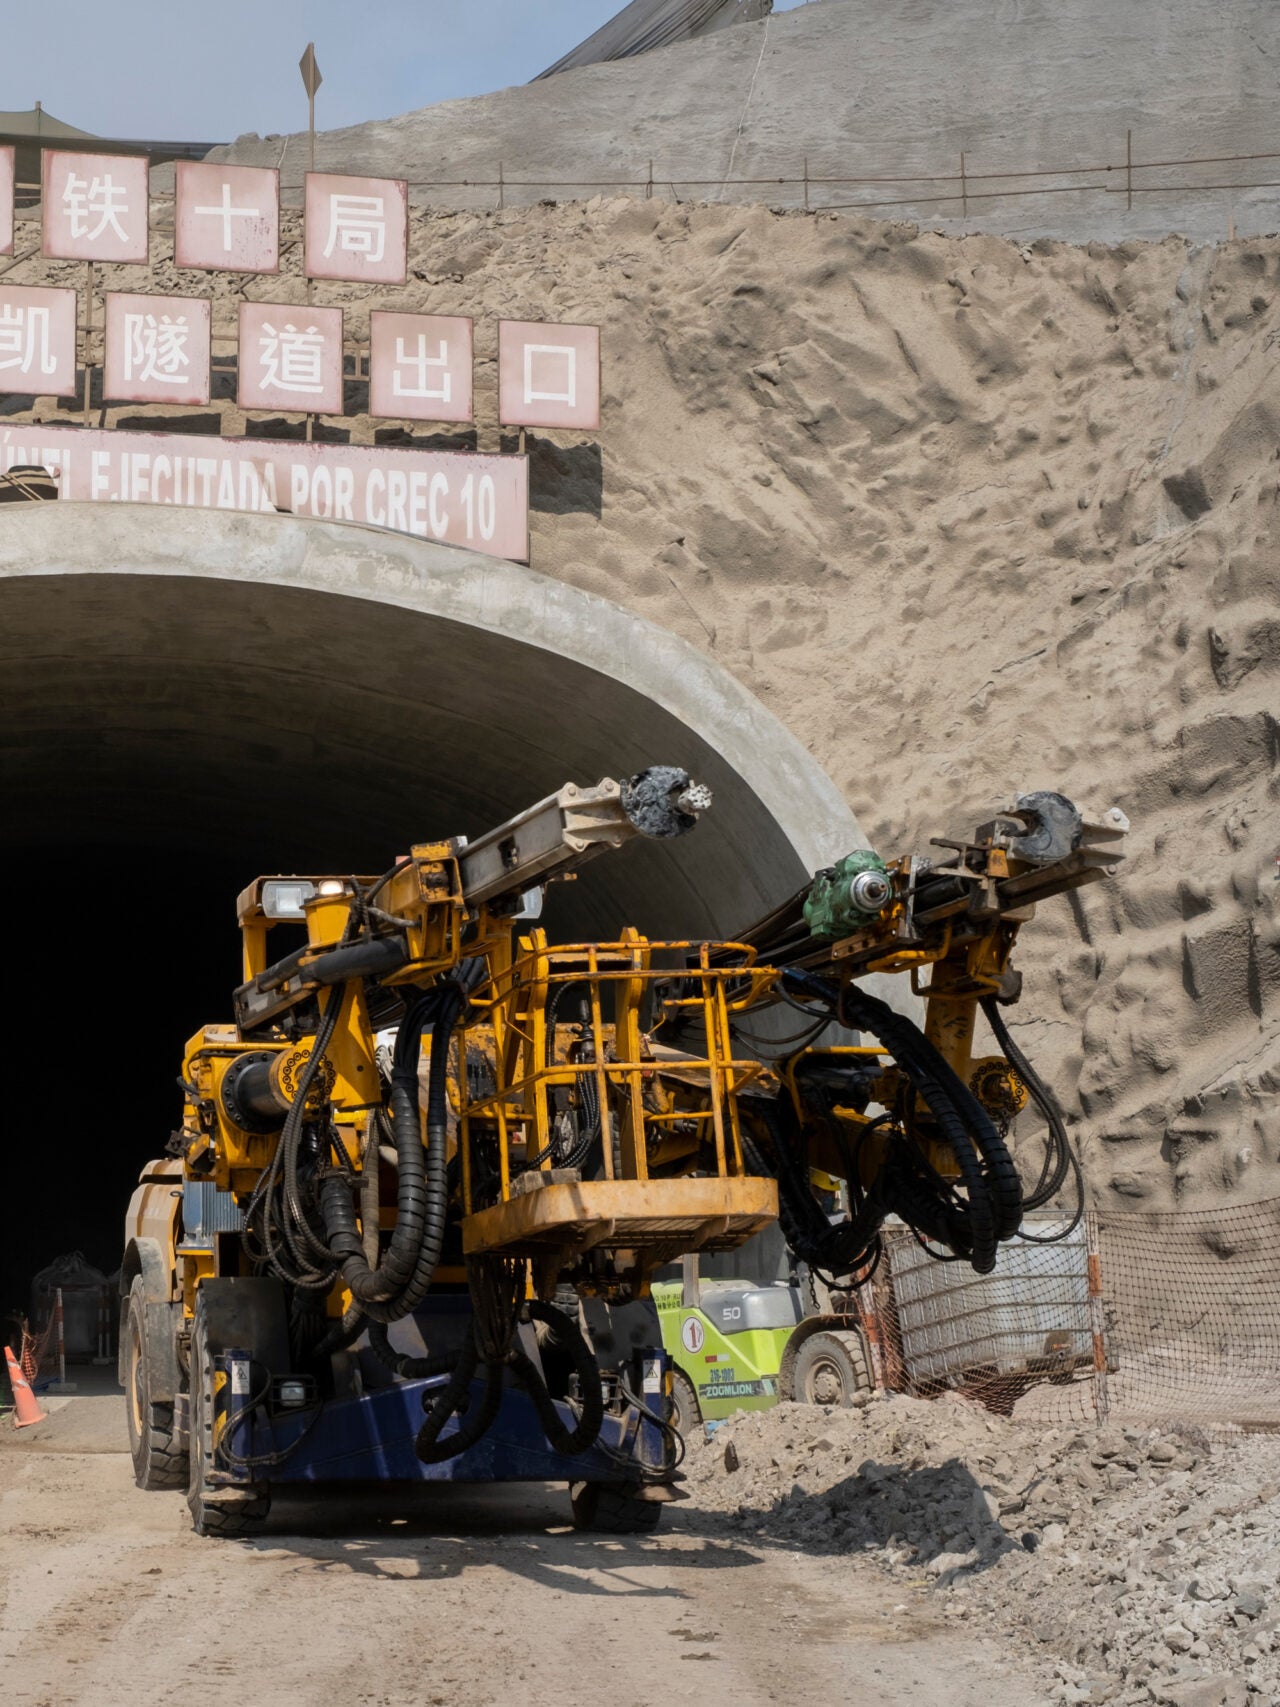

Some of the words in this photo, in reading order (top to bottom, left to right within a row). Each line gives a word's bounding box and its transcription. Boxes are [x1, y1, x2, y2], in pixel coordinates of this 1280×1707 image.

[291, 464, 354, 521] POR
[365, 467, 449, 539] CREC
[460, 473, 496, 541] 10
[723, 1307, 741, 1321] 50
